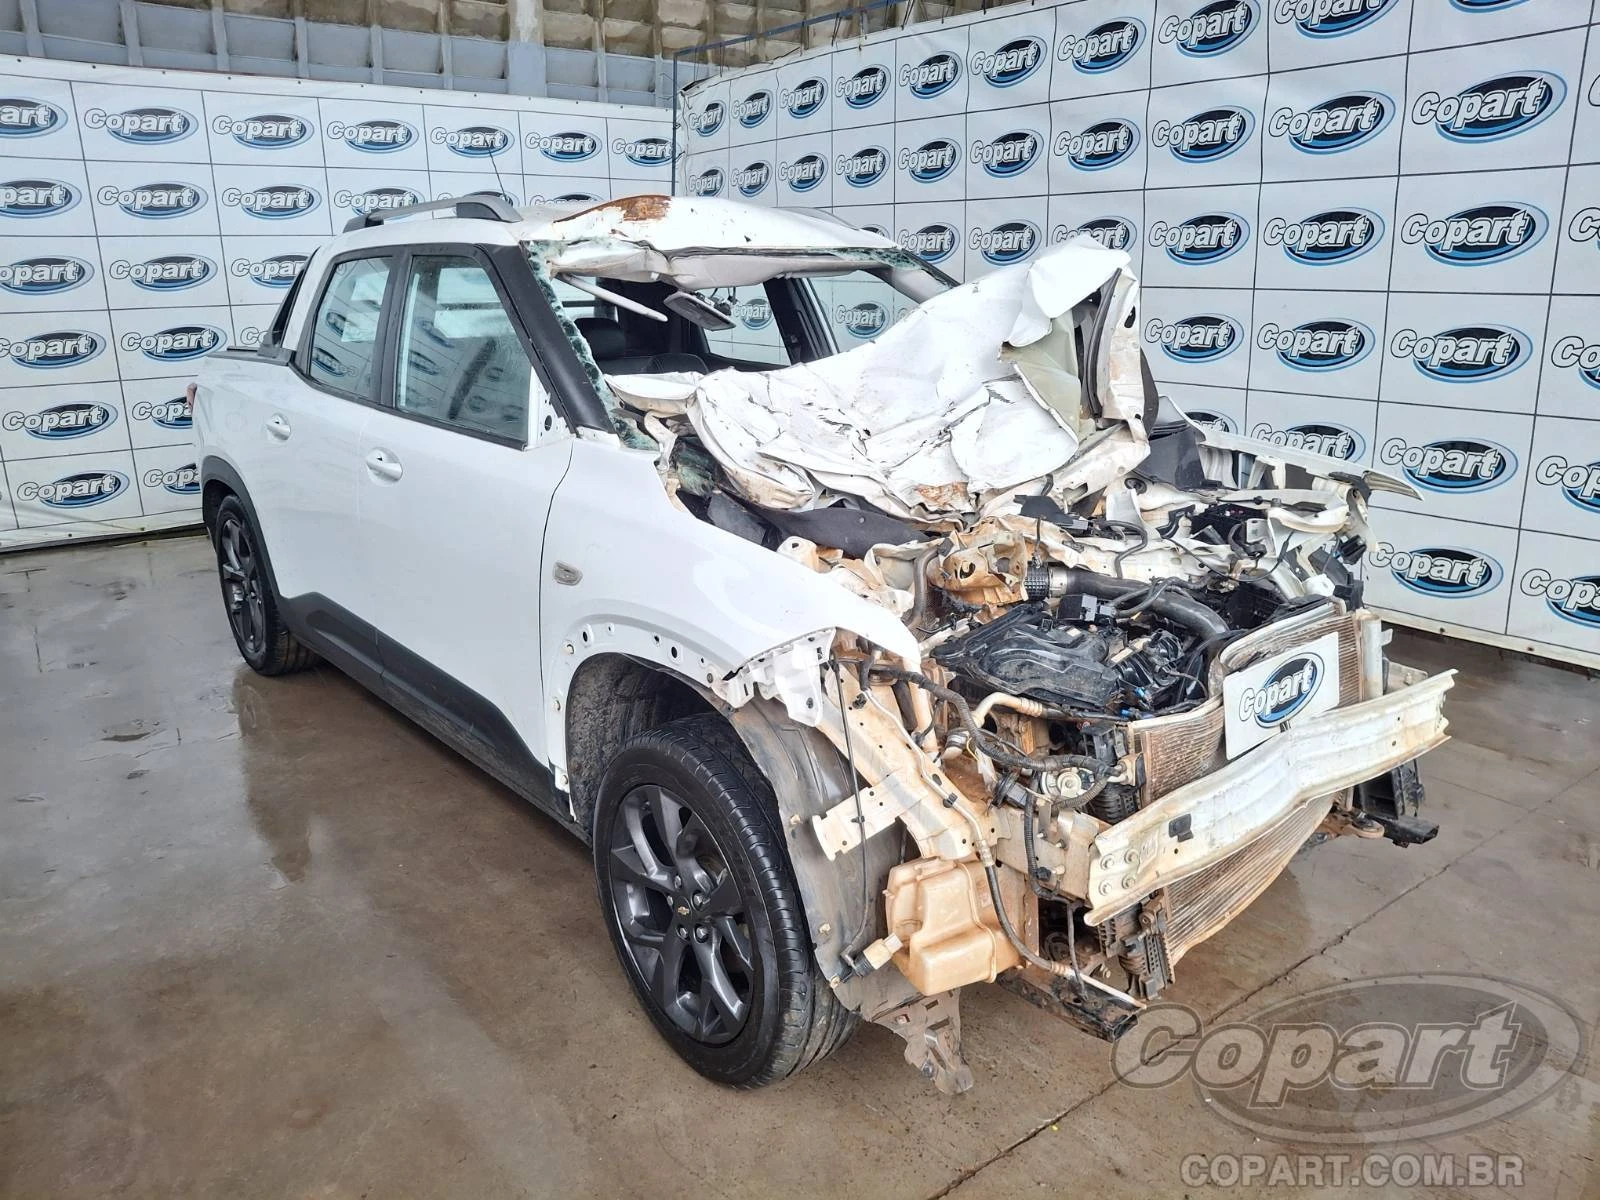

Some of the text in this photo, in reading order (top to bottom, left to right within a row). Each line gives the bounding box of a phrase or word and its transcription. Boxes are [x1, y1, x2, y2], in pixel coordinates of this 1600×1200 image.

[1158, 1, 1249, 48] Copart
[1274, 0, 1382, 28] Copa
[1057, 22, 1136, 64] Copart
[899, 56, 956, 87] Copart
[971, 41, 1038, 78] Copart
[779, 82, 821, 109] Copart
[835, 72, 884, 97] Copart
[0, 104, 50, 127] art
[731, 95, 768, 119] Copart
[1412, 77, 1546, 131] Copart
[84, 108, 184, 134] Copart
[212, 115, 302, 139] Copart
[326, 120, 409, 144] Copart
[1152, 112, 1244, 153] Copart
[1268, 98, 1379, 142] Copart
[430, 126, 504, 149] Copart
[525, 131, 594, 155] Copart
[612, 138, 672, 158] Copart
[970, 135, 1036, 168] Copart
[1053, 125, 1130, 161] Copart
[778, 157, 822, 182] Copart
[835, 153, 884, 177] Copart
[898, 144, 954, 172] Copart
[731, 165, 769, 188] Copart
[0, 184, 65, 208] part
[97, 186, 194, 210] Copart
[222, 188, 310, 212] Copart
[334, 189, 414, 213] Copart
[898, 228, 952, 255] Copart
[968, 226, 1033, 256] Copart
[1149, 219, 1238, 252] Copart
[1264, 214, 1371, 253] Copart
[1401, 210, 1531, 251] Copart
[0, 260, 80, 287] opart
[110, 259, 202, 284] Copart
[231, 258, 305, 280] Copar
[835, 304, 883, 328] Copart
[121, 329, 214, 358] Copart
[1145, 318, 1233, 350] Copart
[1257, 323, 1363, 360] Copart
[1391, 328, 1515, 368] Copart
[2, 404, 103, 433] Copart
[1380, 438, 1504, 480] Copart
[17, 473, 117, 500] Copart
[143, 468, 199, 488] Cop
[1535, 455, 1600, 498] Cop
[1369, 541, 1486, 587] Copart
[1520, 568, 1600, 611] Cop
[1239, 660, 1314, 721] Copart
